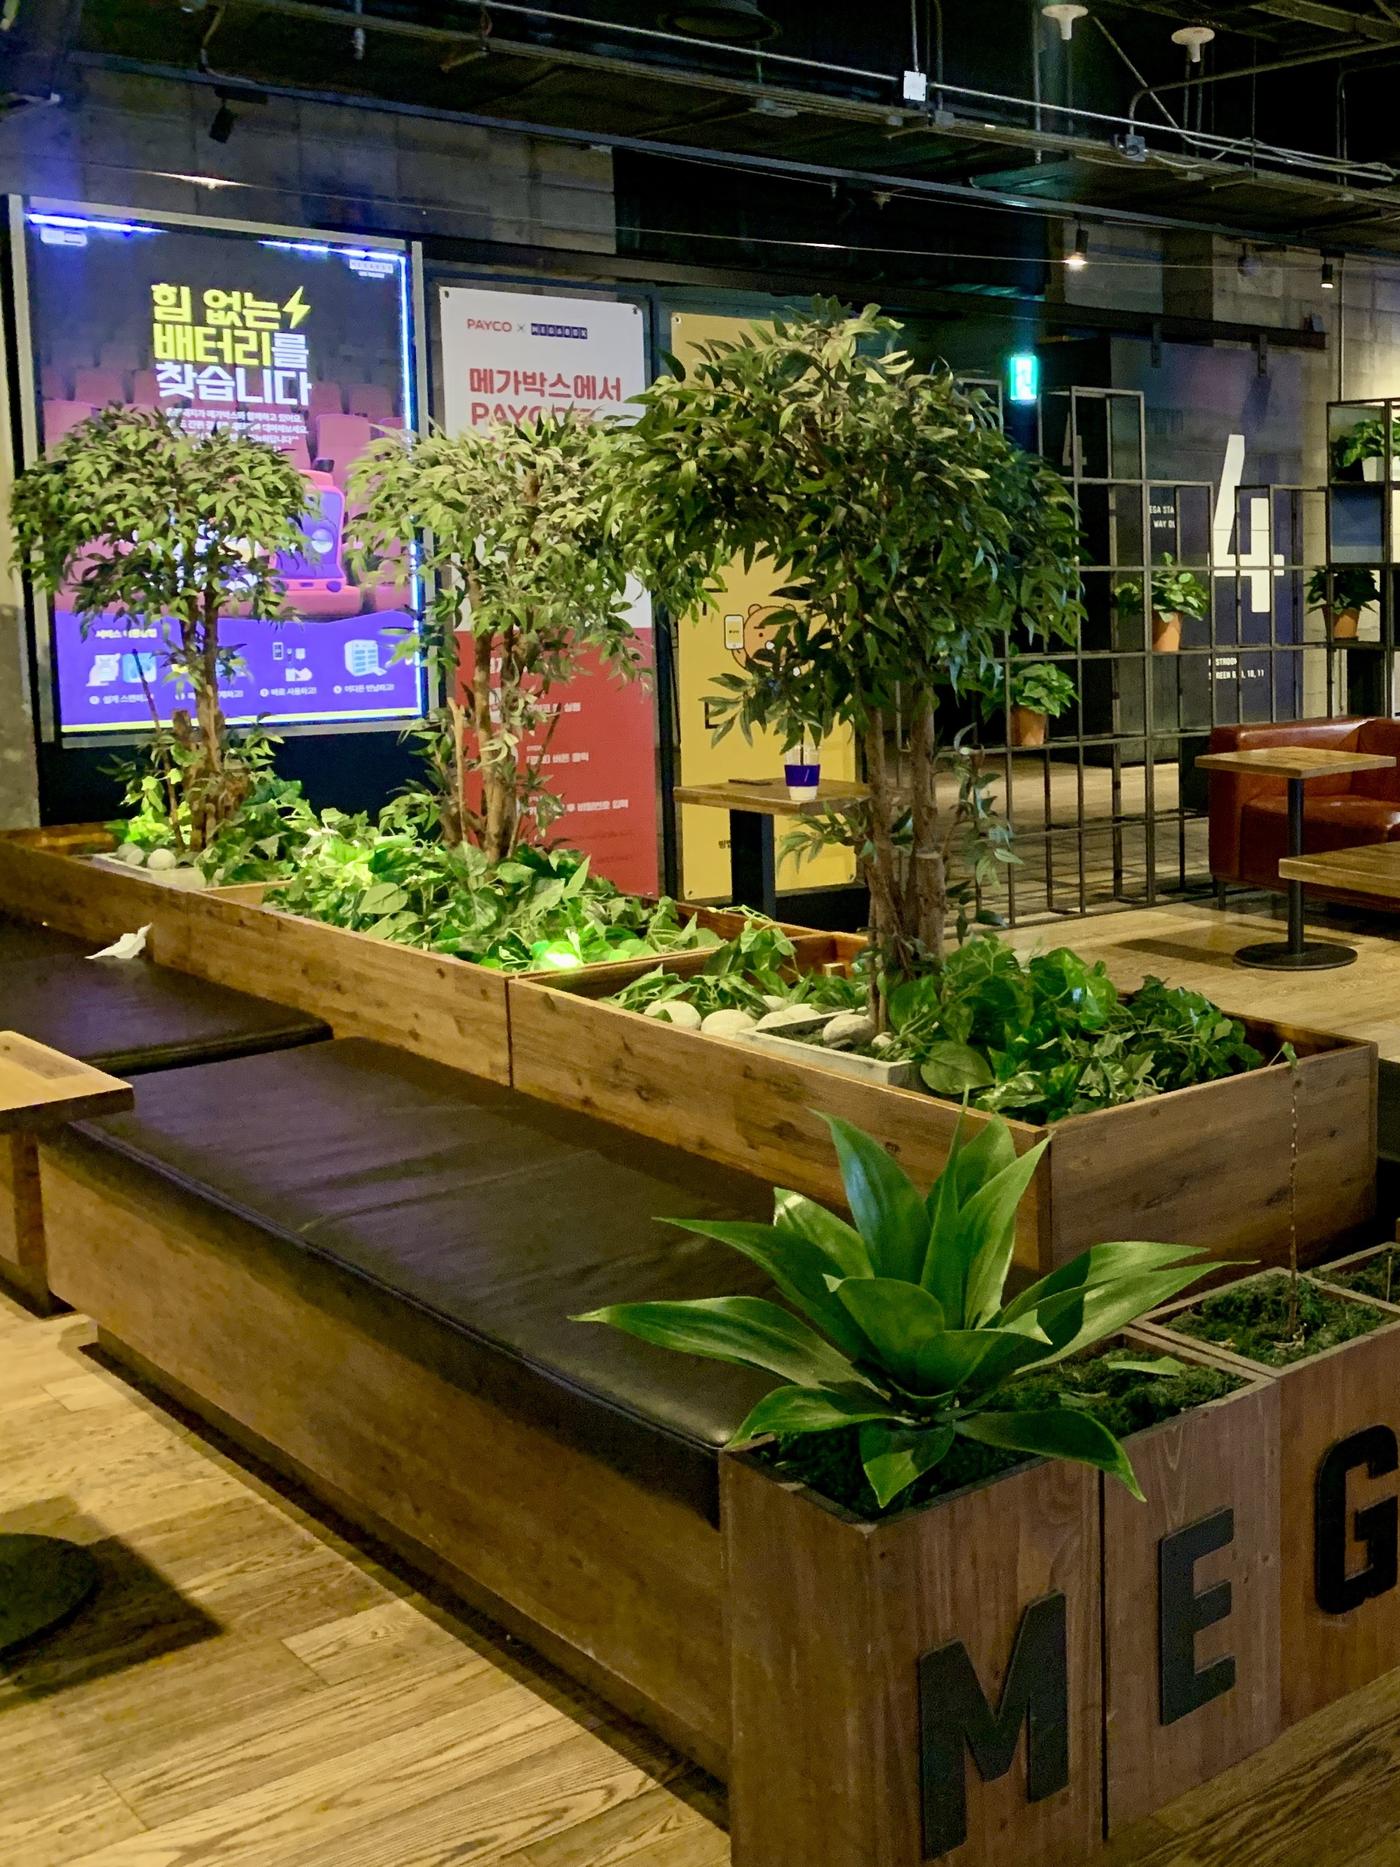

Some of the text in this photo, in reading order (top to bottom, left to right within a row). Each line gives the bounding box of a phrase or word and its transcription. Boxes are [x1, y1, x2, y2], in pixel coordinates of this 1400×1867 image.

[151, 283, 281, 330] 힘 없는
[467, 318, 513, 333] PAYCO
[153, 323, 309, 369] 배터리를
[530, 323, 588, 340] MEGABOX
[155, 361, 313, 406] 찾습니다
[469, 367, 622, 402] 메가박스에서
[1208, 434, 1285, 613] 4
